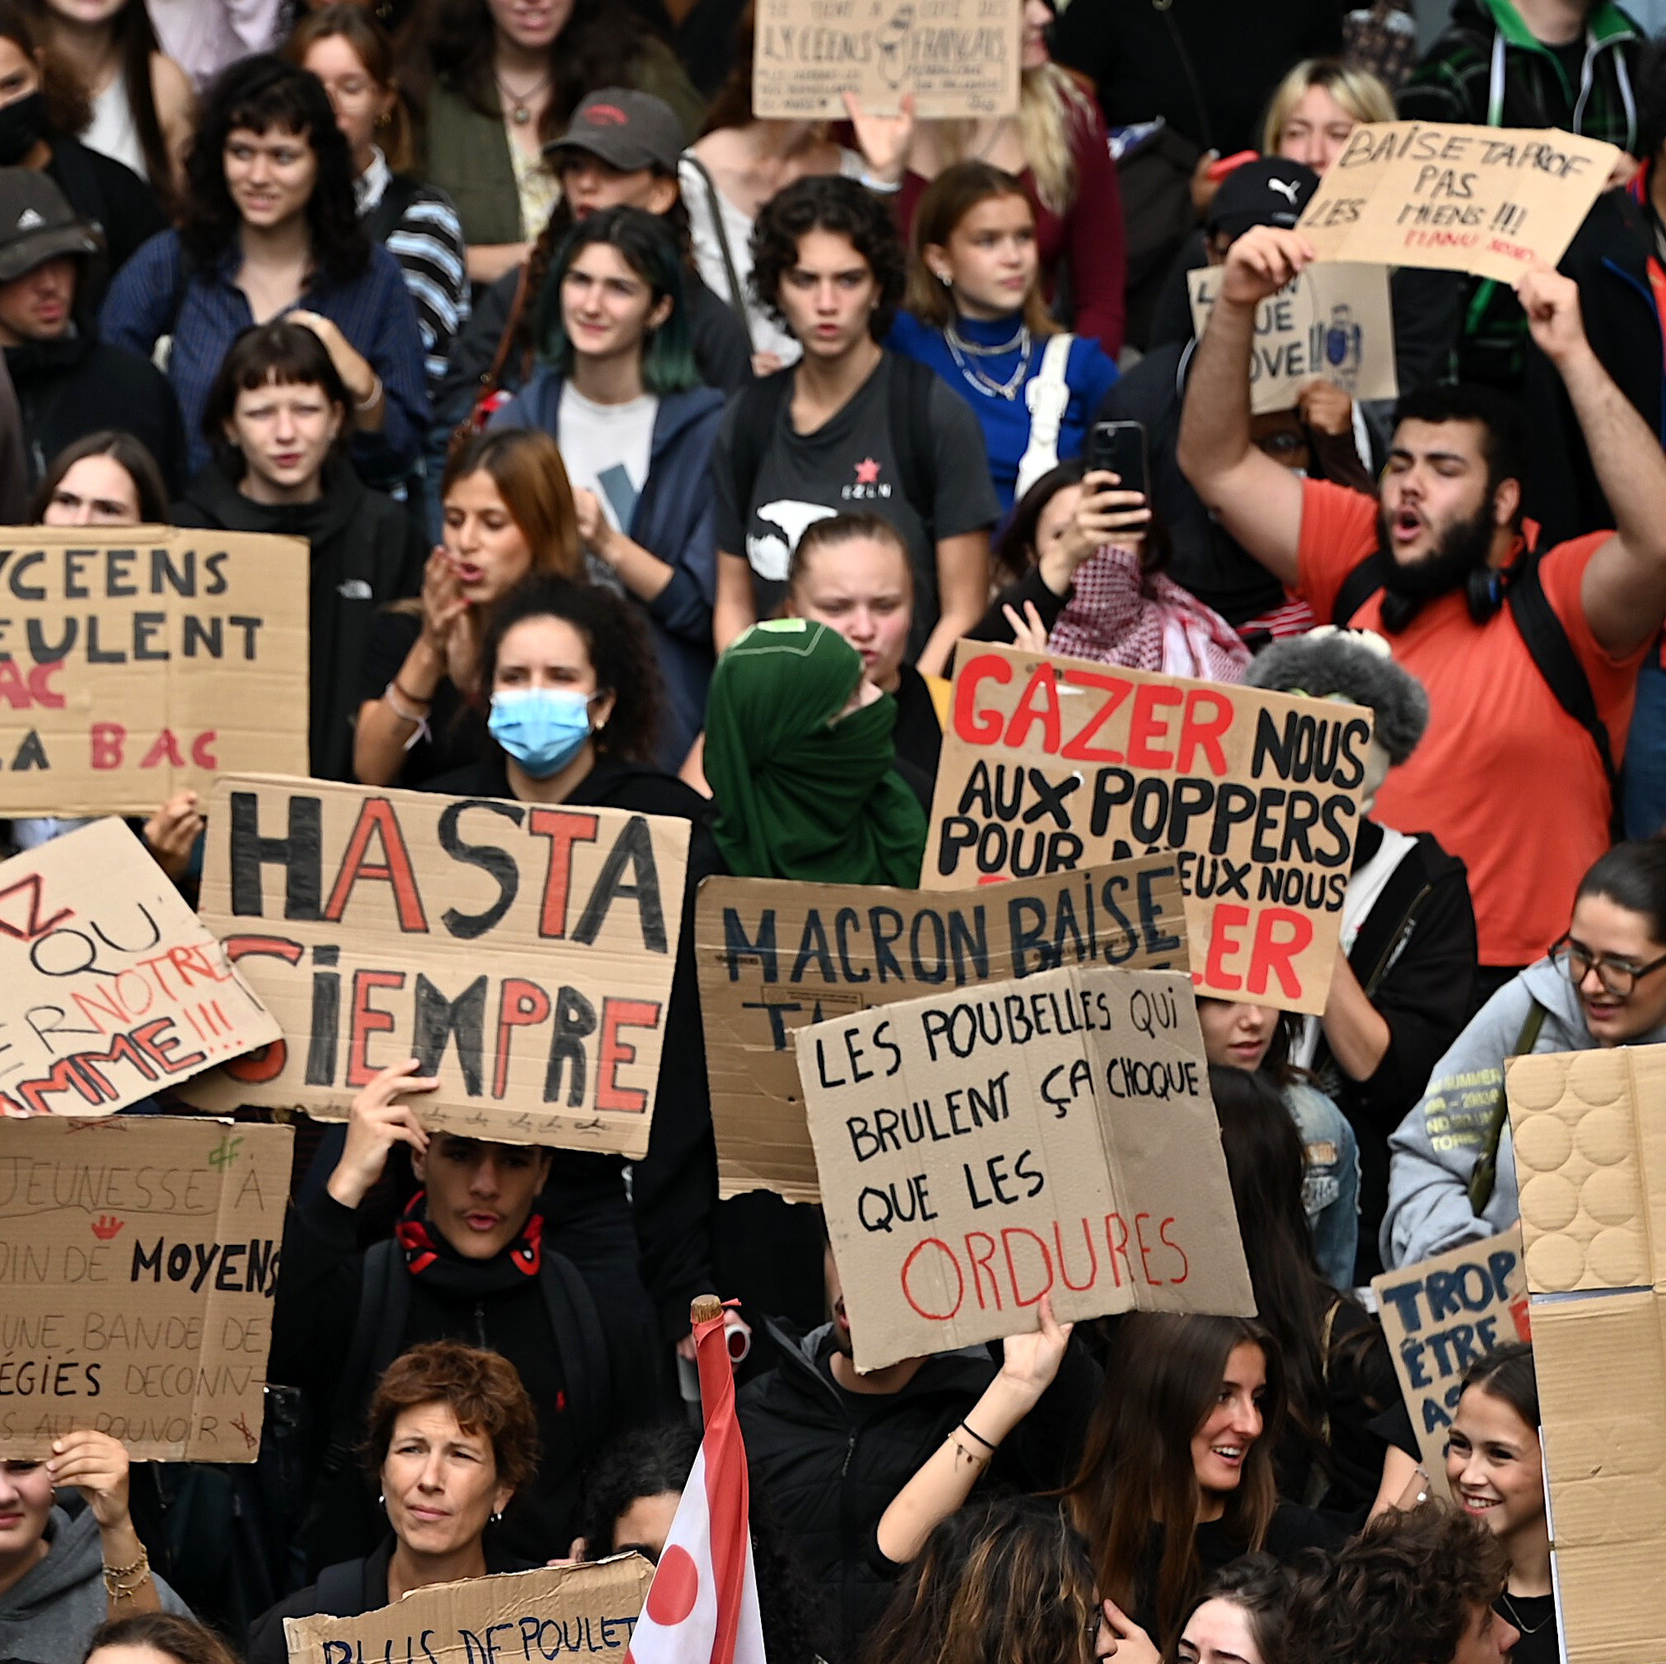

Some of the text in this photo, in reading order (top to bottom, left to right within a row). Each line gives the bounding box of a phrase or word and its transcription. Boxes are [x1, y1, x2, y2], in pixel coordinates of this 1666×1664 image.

[1302, 198, 1365, 227] LES
[1413, 165, 1480, 198] PAS
[91, 722, 217, 770] BAC
[953, 655, 1369, 789] GAZER NOUS
[957, 760, 1355, 867] AUX POPPERS
[231, 791, 668, 954] HASTA
[1259, 867, 1346, 911] NOUS
[722, 904, 990, 987] MACRON
[70, 940, 234, 1036] NOTRE
[816, 1020, 903, 1090] LES
[922, 989, 1112, 1063] POUBELLES
[1130, 987, 1179, 1040] QUI
[846, 1058, 1201, 1162] BRULENT ÇA CHOQUE
[858, 1149, 1045, 1233] QUE LES
[63, 1246, 111, 1283] DE
[131, 1236, 281, 1298] MOYENS
[901, 1213, 1189, 1321] ORDURES
[1381, 1251, 1517, 1335] TROP
[82, 1311, 202, 1352] BANDE
[222, 1316, 267, 1354] DE
